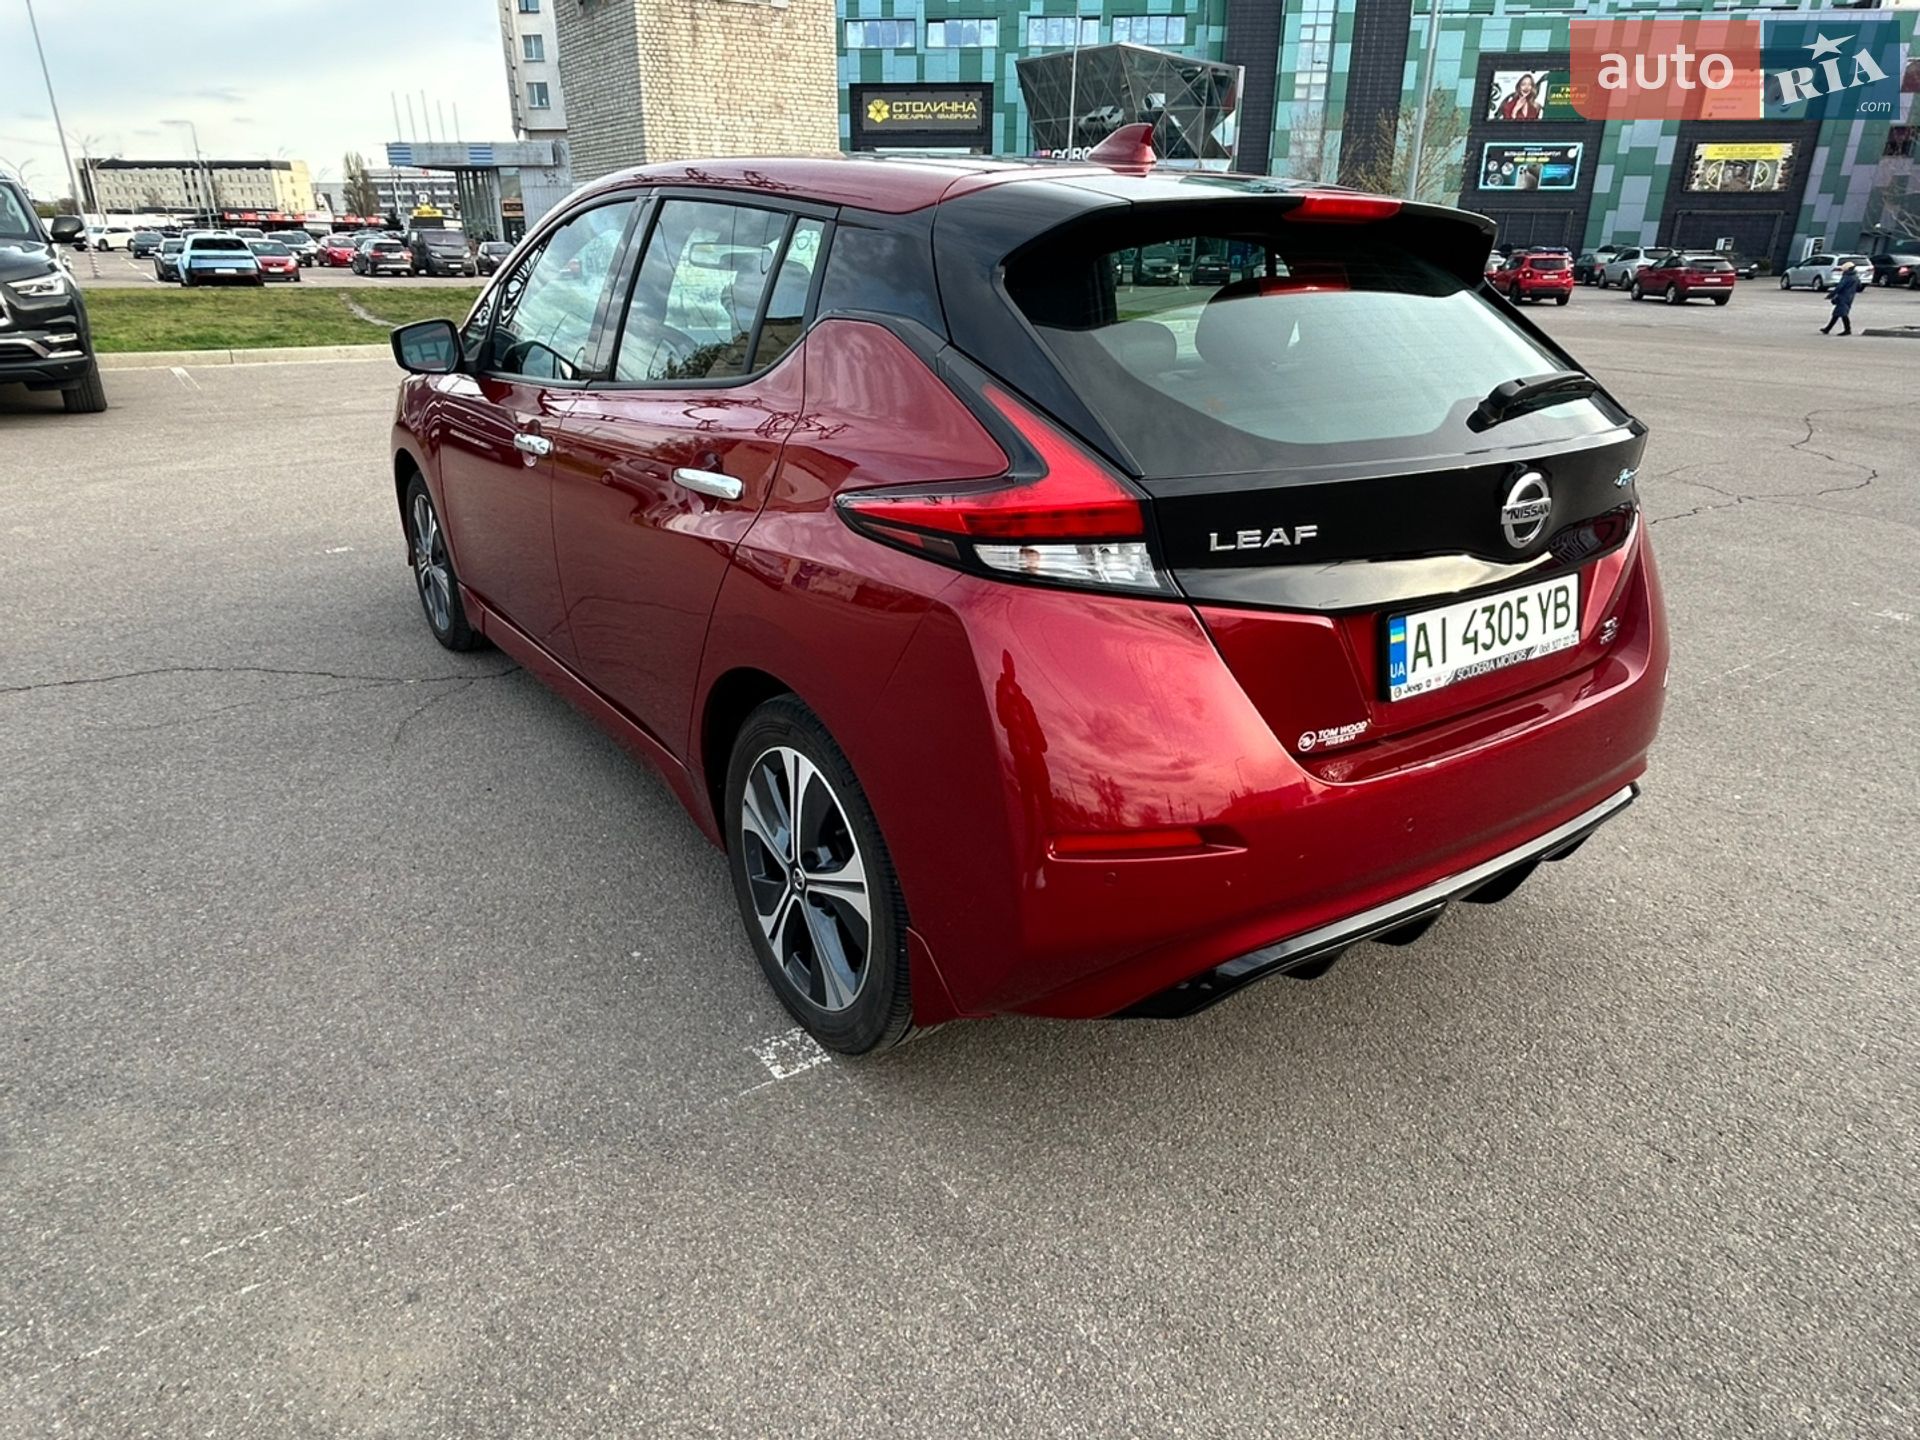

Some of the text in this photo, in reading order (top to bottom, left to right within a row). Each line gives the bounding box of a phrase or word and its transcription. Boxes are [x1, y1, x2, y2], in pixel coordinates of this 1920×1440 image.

[892, 101, 977, 113] СТОЛИЧНА
[1507, 503, 1550, 520] NISSAN
[1209, 525, 1318, 551] LEAF
[1411, 617, 1447, 673] AI
[1462, 595, 1529, 655] 4305
[1537, 585, 1571, 635] YB
[1390, 662, 1406, 679] UA
[1318, 720, 1368, 739] TOM WOOD
[1325, 734, 1356, 747] NISSAN
